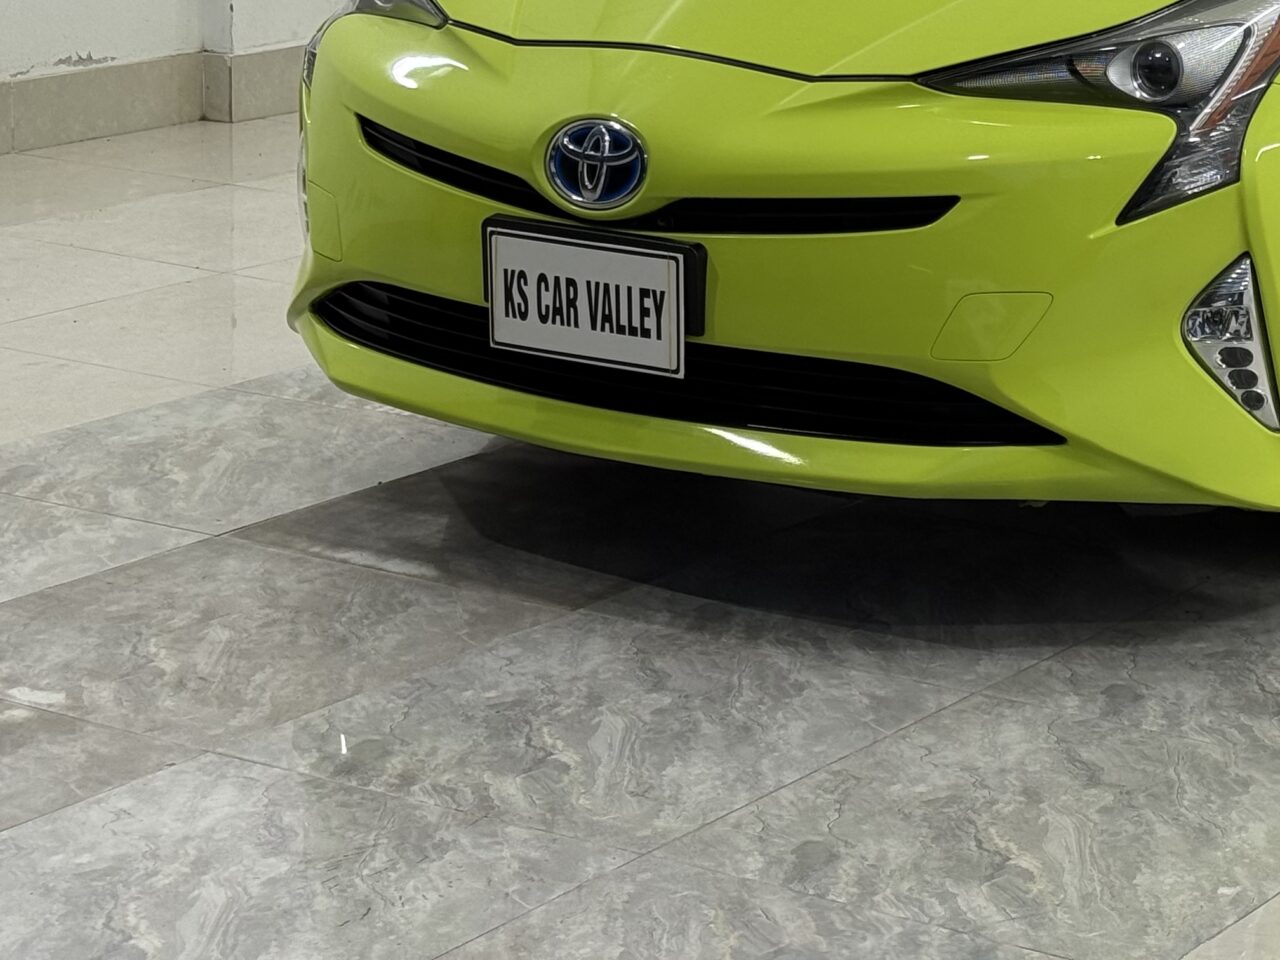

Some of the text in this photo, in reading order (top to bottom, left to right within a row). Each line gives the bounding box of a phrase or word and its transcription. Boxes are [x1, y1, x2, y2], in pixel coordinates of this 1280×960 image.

[503, 268, 666, 341] KS CAR VALLEY
